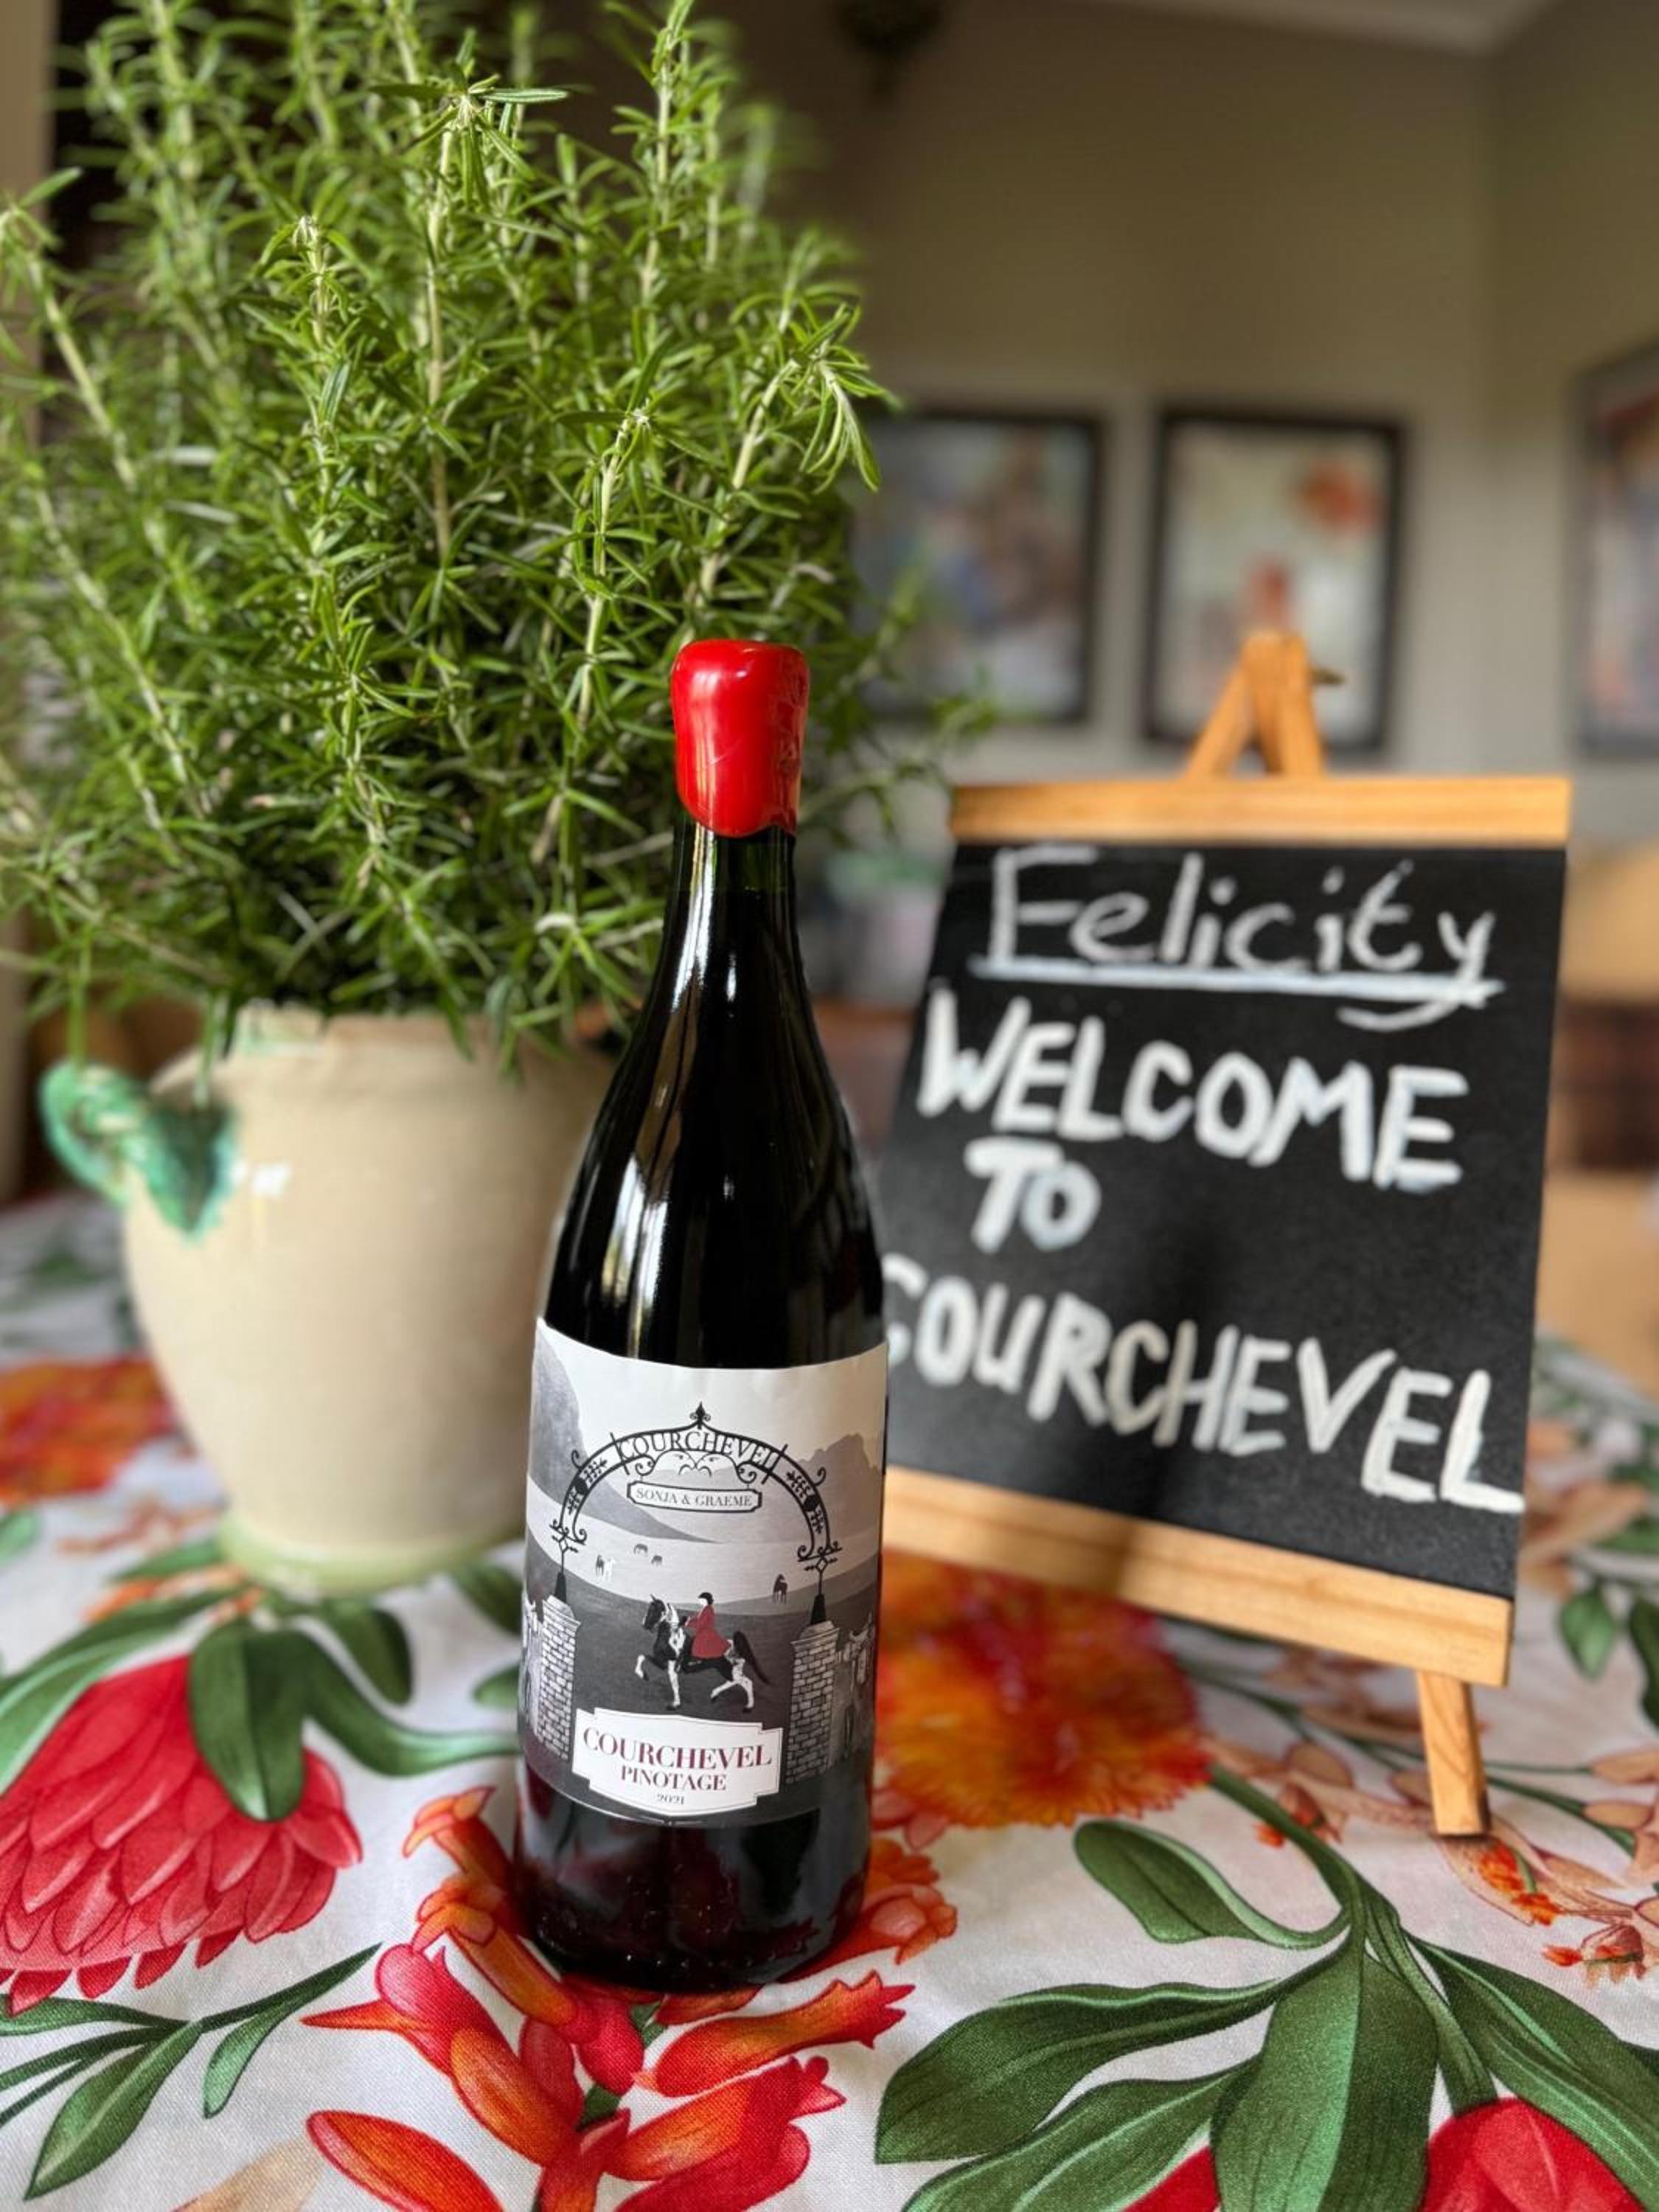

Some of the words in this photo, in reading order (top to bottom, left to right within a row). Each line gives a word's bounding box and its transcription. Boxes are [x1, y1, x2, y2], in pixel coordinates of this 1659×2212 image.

[990, 847, 1495, 1029] Felicity
[919, 987, 1469, 1191] WELCOME
[964, 1137, 1100, 1252] TO
[619, 1430, 776, 1470] COURCHEVEL
[636, 1487, 677, 1505] SONJA
[681, 1495, 692, 1506] &
[695, 1495, 753, 1507] GRAEME
[582, 1727, 773, 1770] COURCHEVEL
[620, 1764, 727, 1792] PINOTAGE
[657, 1793, 685, 1806] 2021
